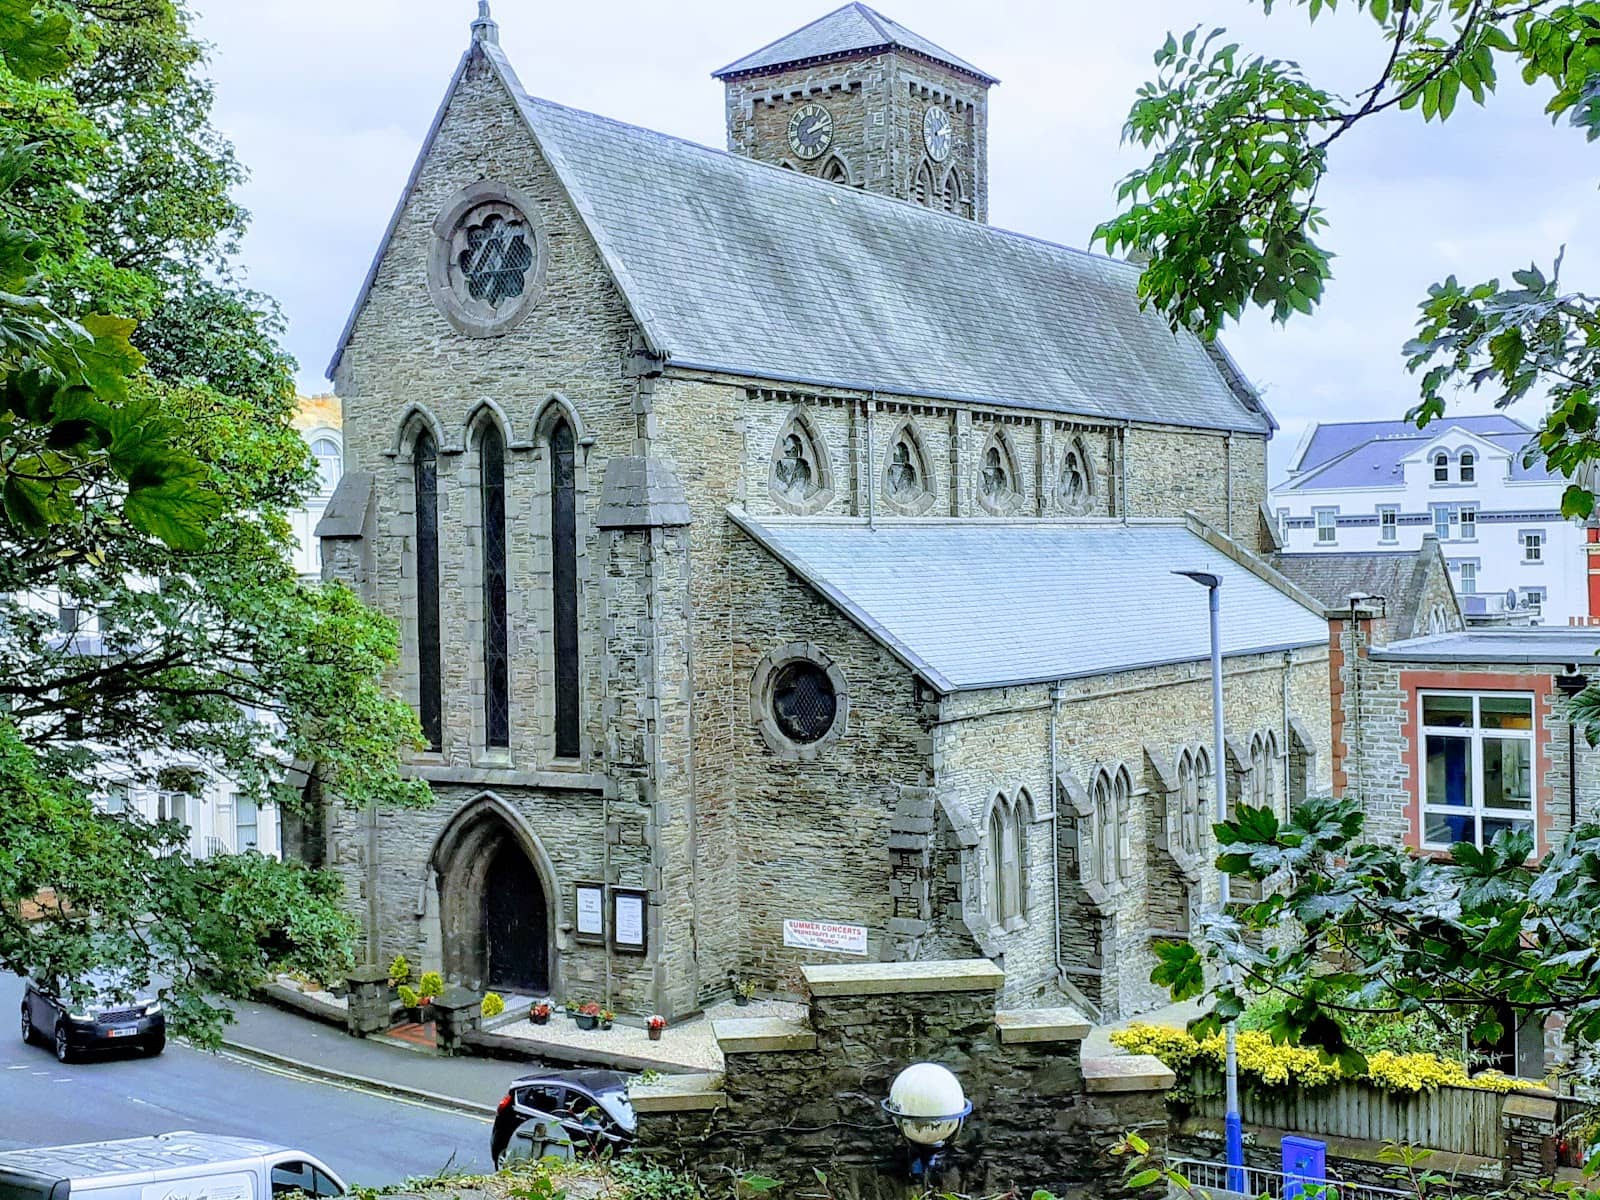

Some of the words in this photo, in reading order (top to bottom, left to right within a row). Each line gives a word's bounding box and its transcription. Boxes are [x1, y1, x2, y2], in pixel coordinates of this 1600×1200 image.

[789, 921, 821, 930] SUMMER
[822, 926, 861, 935] CONCERTS
[793, 929, 829, 938] WEDNESDAYS
